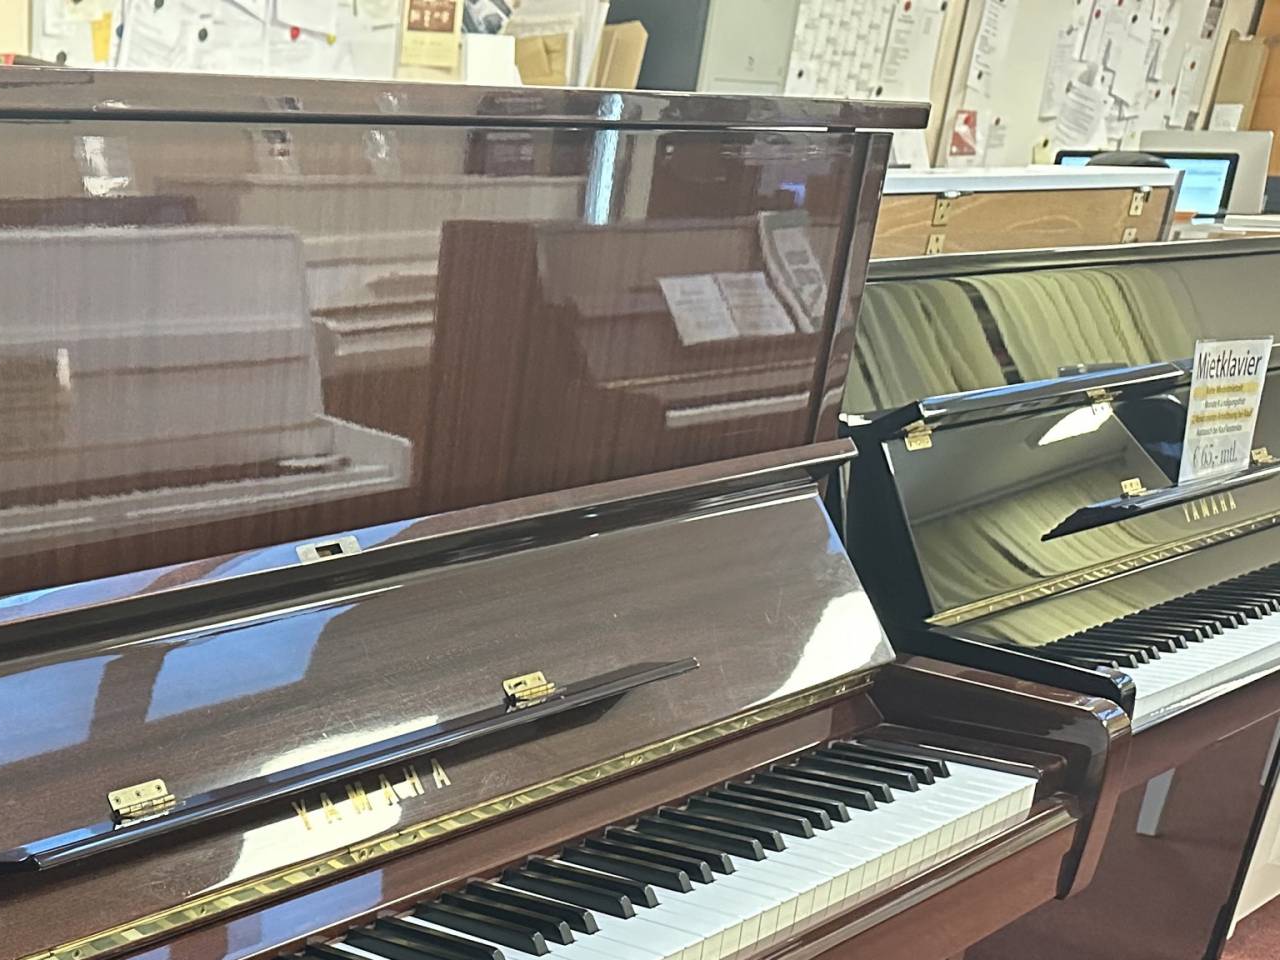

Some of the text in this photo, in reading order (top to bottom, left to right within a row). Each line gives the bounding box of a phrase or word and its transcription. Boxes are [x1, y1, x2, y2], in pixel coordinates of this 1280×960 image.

[1196, 350, 1263, 380] Mietklavier
[1182, 491, 1237, 523] YAMAHA
[291, 757, 452, 830] YAMAHA
